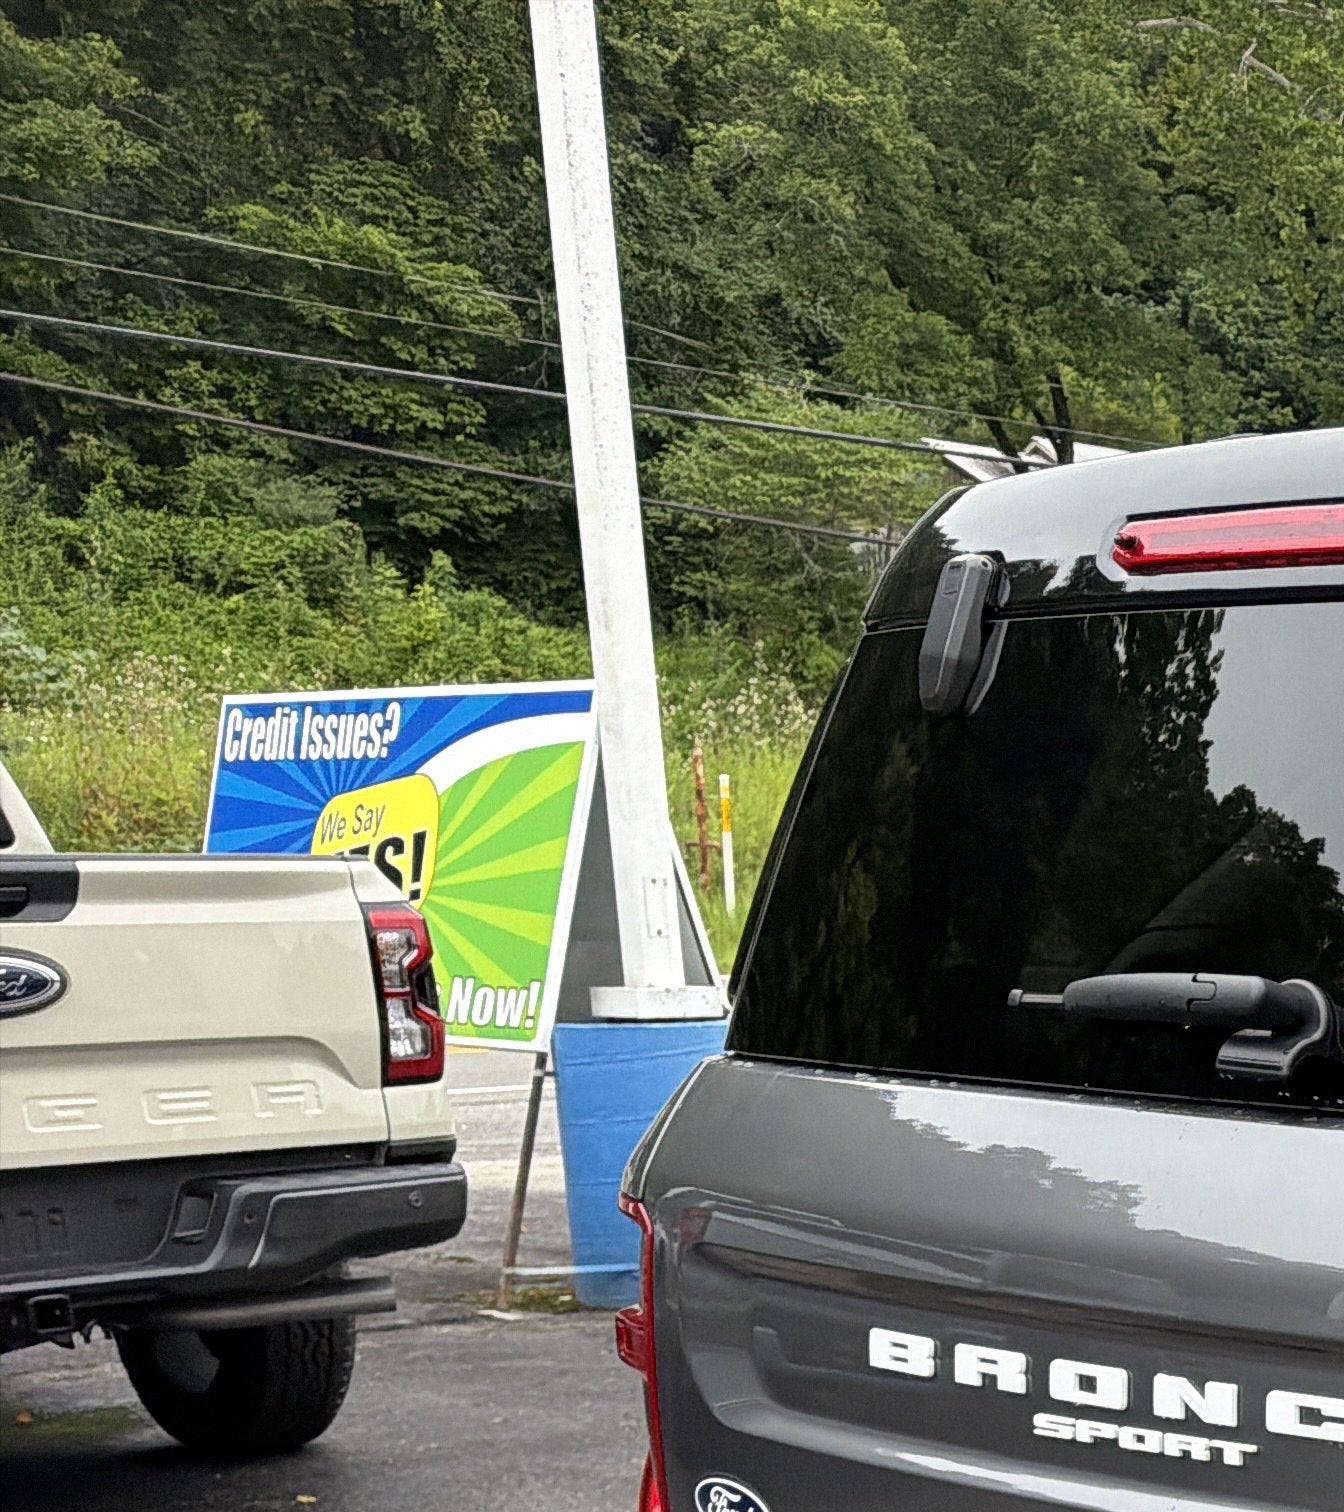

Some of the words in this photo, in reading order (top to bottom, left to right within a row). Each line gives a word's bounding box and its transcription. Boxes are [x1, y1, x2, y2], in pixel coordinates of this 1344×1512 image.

[224, 706, 298, 763] Credit
[300, 701, 401, 761] Issues?
[320, 810, 347, 845] We
[352, 803, 386, 838] Say
[334, 830, 427, 901] S!
[445, 975, 541, 1029] Now!
[1033, 1412, 1260, 1467] SPORT
